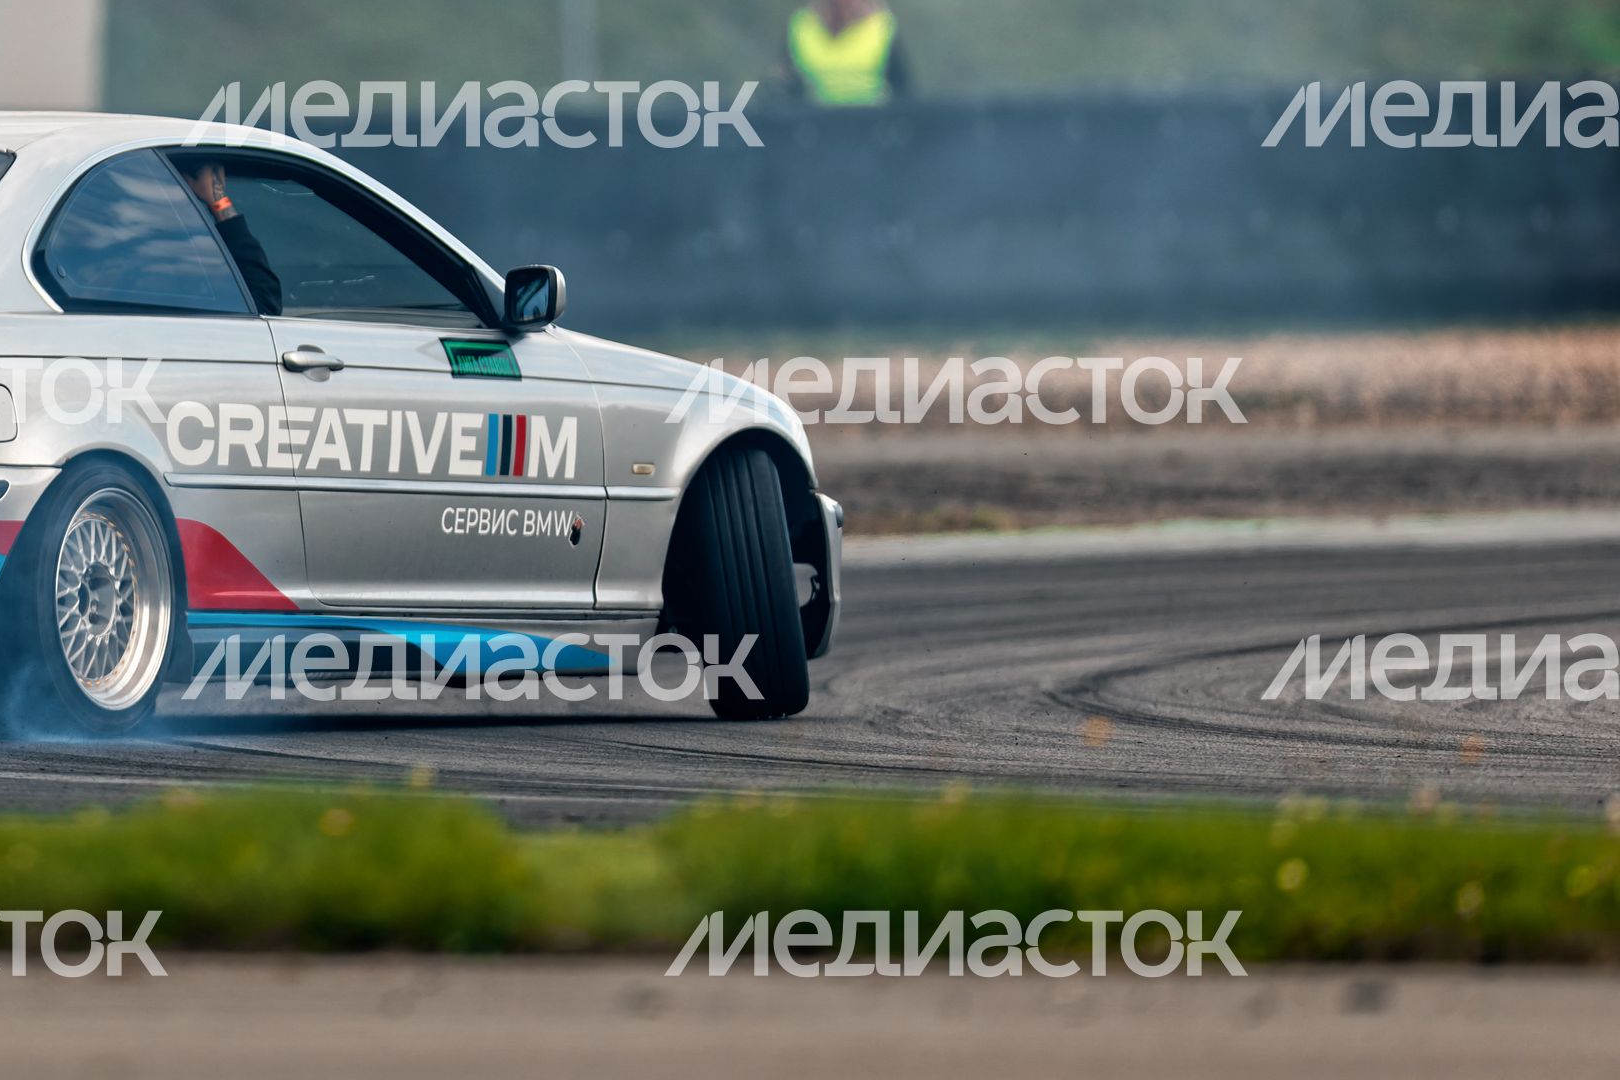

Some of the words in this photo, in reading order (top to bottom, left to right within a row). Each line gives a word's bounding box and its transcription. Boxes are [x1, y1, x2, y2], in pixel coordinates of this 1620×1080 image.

[165, 400, 485, 477] CREATIVE
[441, 506, 519, 535] СЕРВИС
[522, 509, 574, 537] BMW
